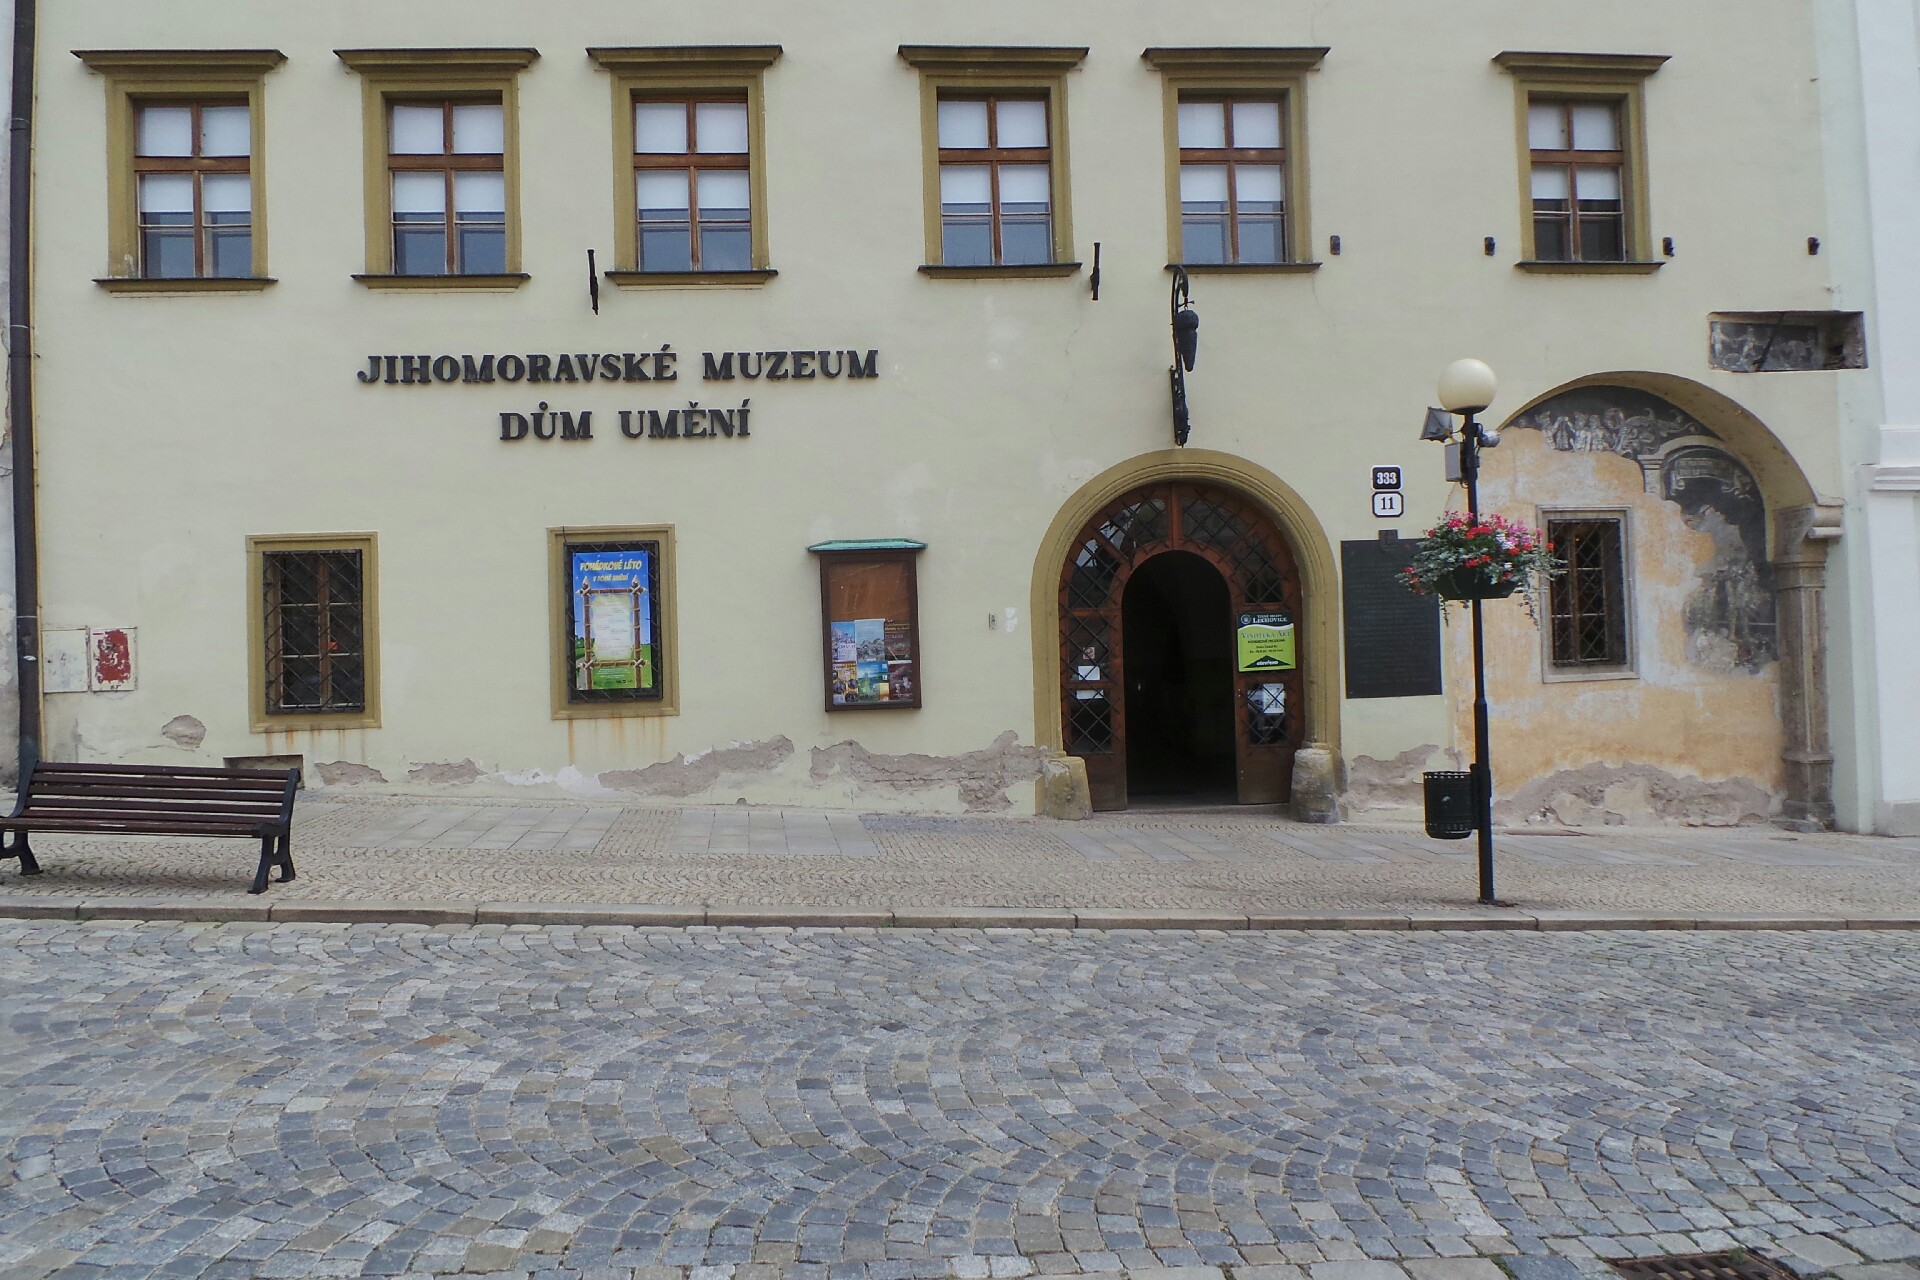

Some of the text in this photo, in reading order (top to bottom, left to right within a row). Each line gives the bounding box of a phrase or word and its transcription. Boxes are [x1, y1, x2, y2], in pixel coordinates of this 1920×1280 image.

[358, 344, 879, 383] JIHOMORAVSKÉ MUZEUM
[499, 398, 751, 440] DŮM UMĚNÍ
[1377, 472, 1397, 484] 333
[1380, 496, 1395, 510] 11
[580, 559, 642, 571] POHÁDKOVÉ LÉTO
